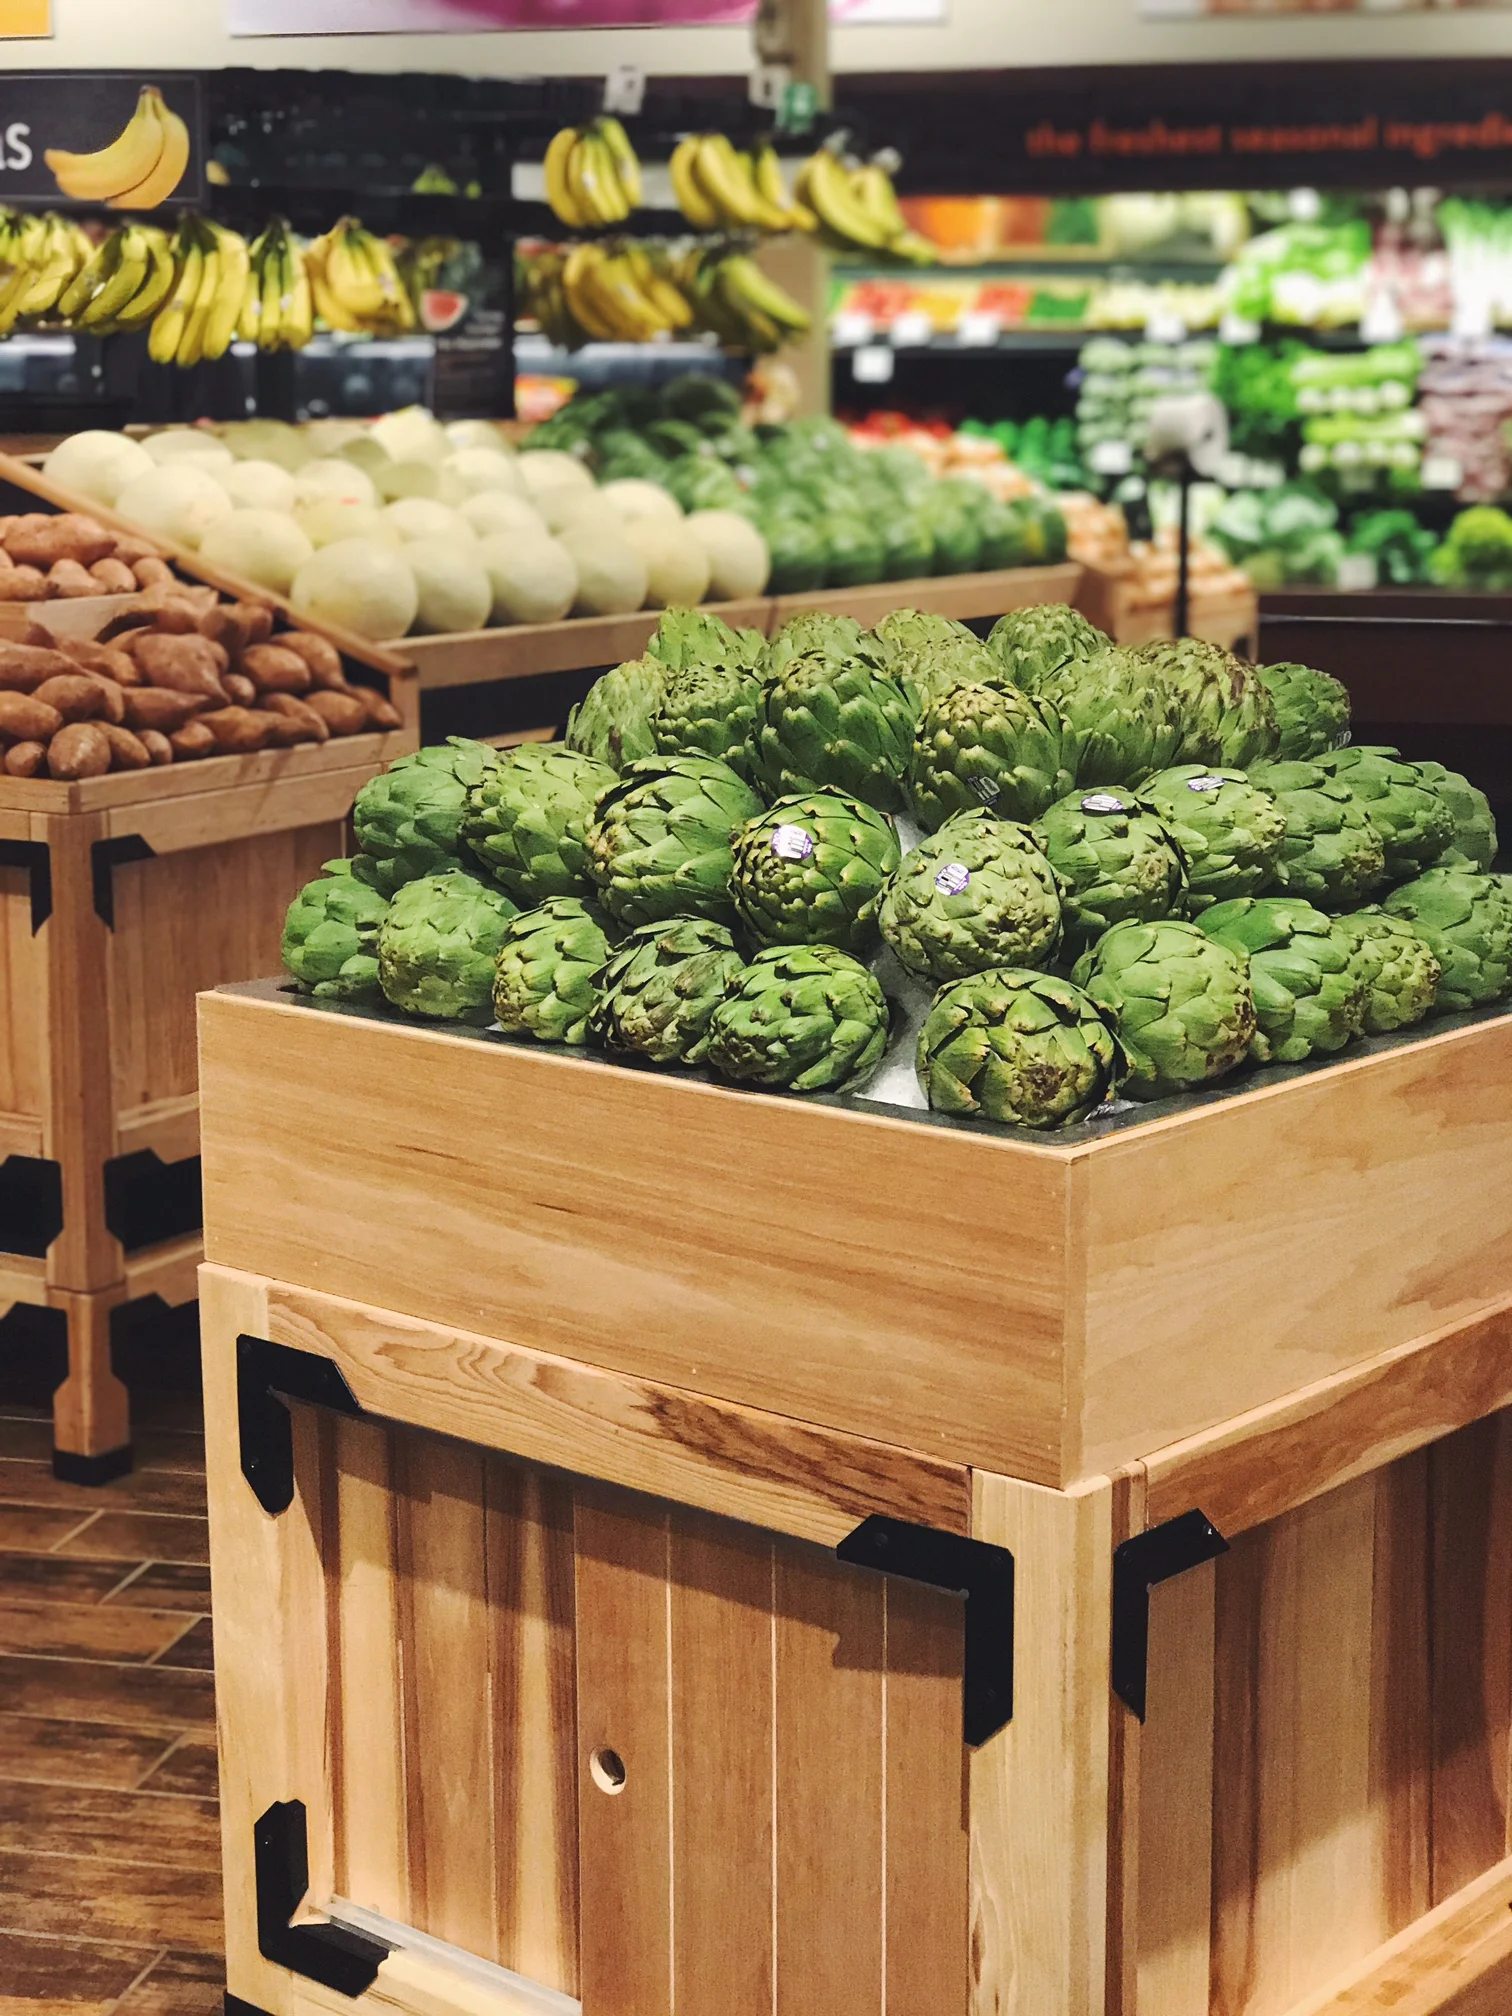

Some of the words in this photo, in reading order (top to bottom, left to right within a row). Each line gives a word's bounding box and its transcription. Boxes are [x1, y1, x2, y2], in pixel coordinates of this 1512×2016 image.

[1024, 121, 1082, 156] the
[1089, 117, 1222, 154] freshest
[1230, 115, 1378, 153] seasonal
